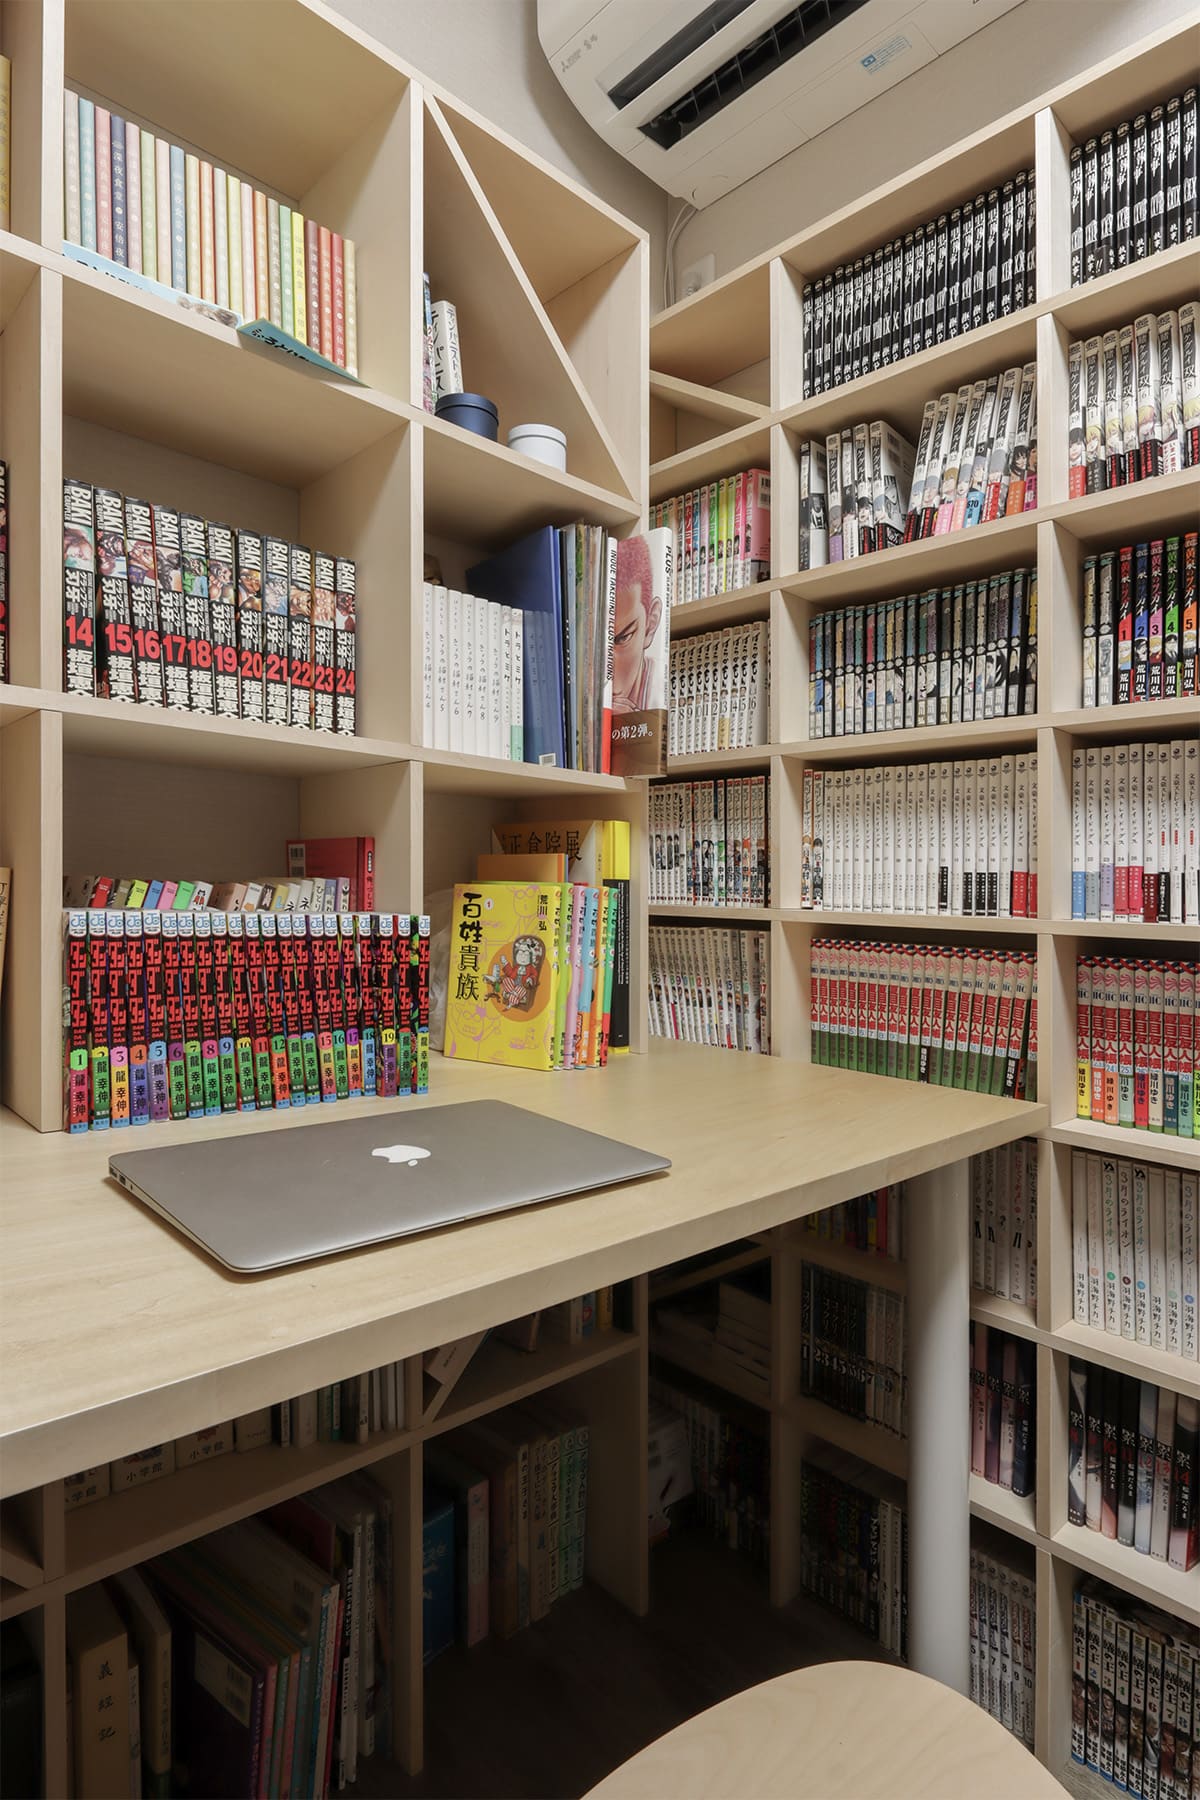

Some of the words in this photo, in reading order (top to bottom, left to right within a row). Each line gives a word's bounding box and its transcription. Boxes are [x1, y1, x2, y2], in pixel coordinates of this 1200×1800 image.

[71, 486, 93, 526] BAKI
[102, 495, 124, 536] BAKI
[131, 504, 154, 543] BAKI
[158, 512, 180, 550] BAKI
[187, 518, 208, 555] BAKI
[214, 528, 232, 566] BAKI
[244, 536, 261, 572] BAKI
[271, 542, 288, 577] BAKI
[665, 545, 673, 574] PLUS
[296, 550, 311, 588] BAKI
[319, 557, 334, 591] BAKI
[609, 550, 617, 574] INOUE
[341, 562, 356, 596] BAKI
[608, 577, 617, 618] TAKEHIKO
[66, 615, 93, 647] 14
[105, 623, 132, 653] 15
[1121, 629, 1126, 640] 1
[1137, 625, 1145, 637] 2
[1152, 624, 1159, 635] 3
[1168, 621, 1175, 632] 4
[1185, 618, 1193, 629] 5
[135, 629, 160, 659] 16
[163, 634, 186, 663] 17
[188, 639, 211, 668] 18
[606, 618, 616, 681] ILLUSTRATIONS
[214, 645, 237, 673] 19
[241, 650, 262, 679] 20
[267, 654, 288, 682] 21
[291, 660, 311, 687] 22
[315, 664, 333, 692] 23
[336, 667, 355, 695] 24
[1136, 665, 1146, 694] 荒川弘
[1166, 665, 1176, 695] 荒川弘
[1184, 659, 1195, 690] 荒川弘
[612, 723, 654, 741] の第2弾。
[456, 892, 483, 1001] 百姓貴族
[223, 1041, 231, 1052] 9
[259, 1042, 268, 1052] 11
[274, 1039, 285, 1050] 12
[321, 1036, 331, 1046] 15
[334, 1034, 344, 1043] 16
[384, 1033, 394, 1042] 19
[1092, 1006, 1104, 1061] 夏目友人帳
[1119, 1009, 1132, 1066] 夏目友人帳
[1164, 1014, 1178, 1072] 夏目友人帳
[1179, 1015, 1193, 1073] 夏目友人帳
[78, 1054, 83, 1066] 1
[116, 1051, 124, 1062] 3
[135, 1049, 144, 1061] 4
[155, 1045, 163, 1057] 5
[173, 1047, 182, 1058] 6
[207, 1045, 215, 1055] 8
[1120, 1065, 1130, 1073] 25
[189, 1440, 224, 1460] 小学館
[126, 1461, 164, 1482] 小学館
